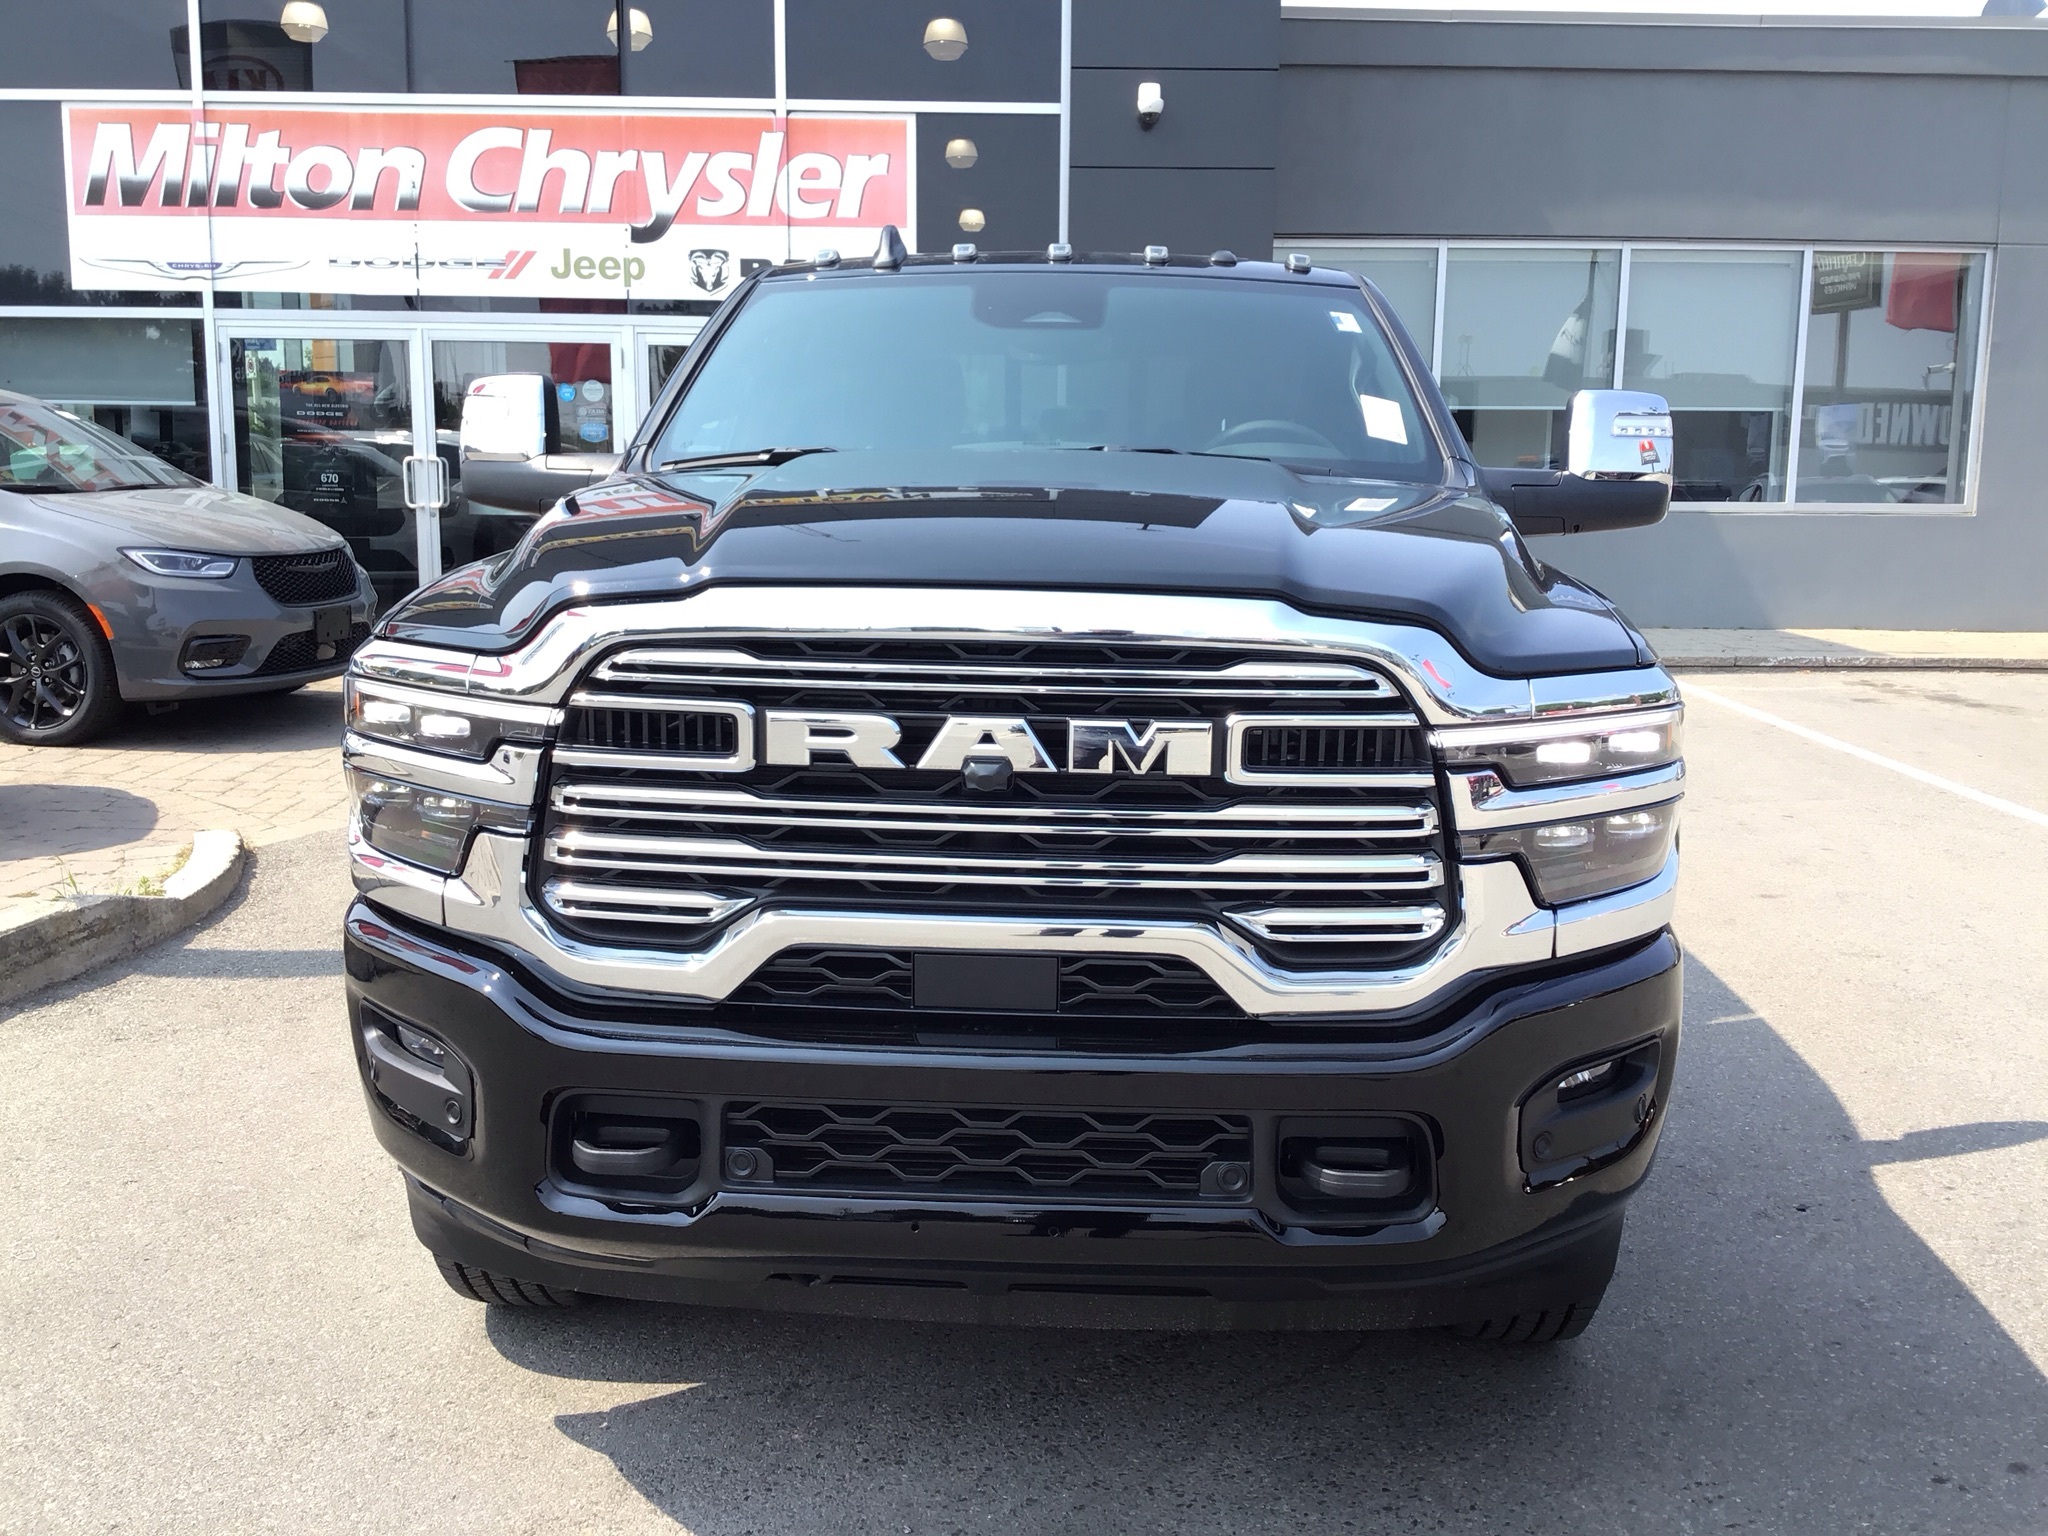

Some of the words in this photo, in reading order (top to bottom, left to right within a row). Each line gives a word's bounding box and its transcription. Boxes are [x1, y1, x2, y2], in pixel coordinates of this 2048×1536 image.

[83, 120, 427, 212] Milton
[445, 126, 891, 244] Chrysler
[329, 253, 509, 270] DODGE
[551, 248, 646, 288] Jeep
[320, 473, 339, 483] 670
[764, 708, 1213, 776] RAM
